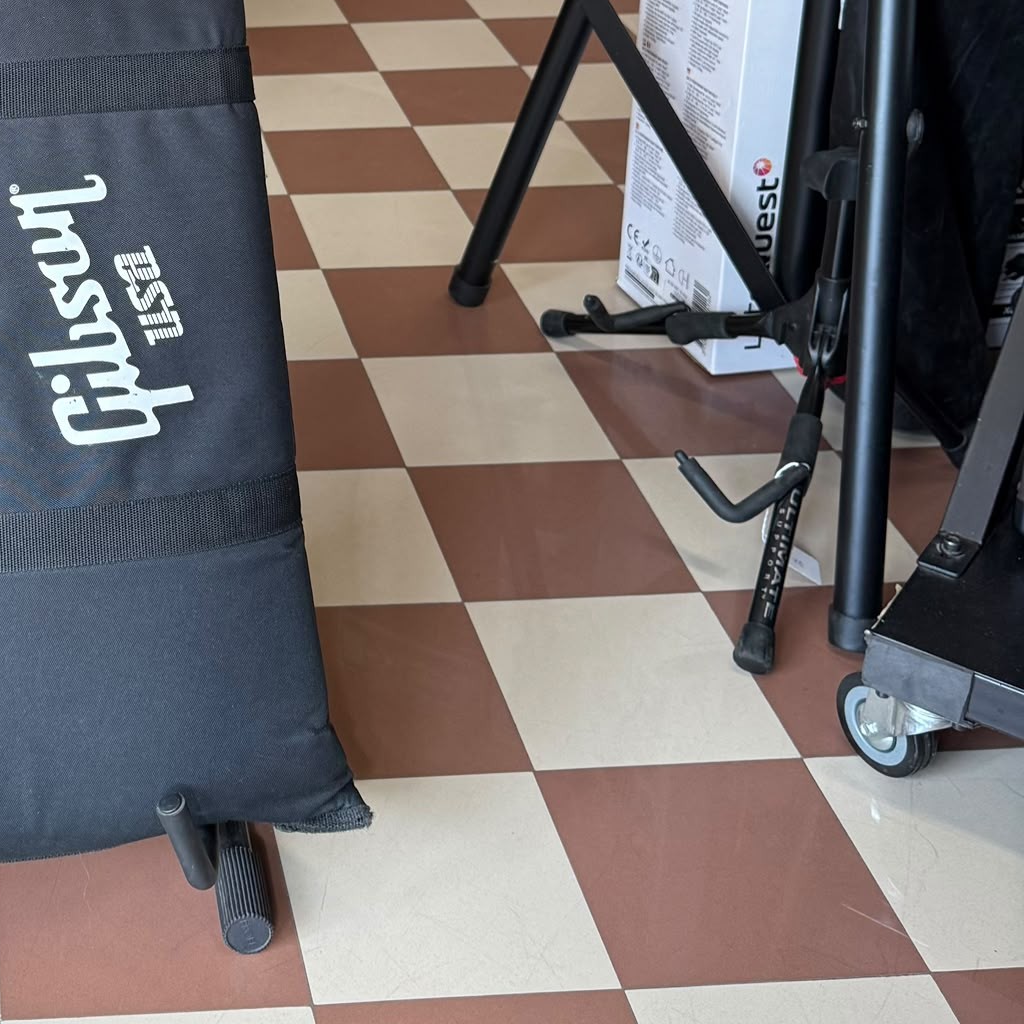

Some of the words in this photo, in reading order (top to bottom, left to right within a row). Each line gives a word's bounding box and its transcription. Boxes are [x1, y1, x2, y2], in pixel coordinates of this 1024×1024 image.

[9, 174, 194, 445] Gibson
[114, 245, 183, 346] USA
[763, 488, 801, 619] ULTIMATE
